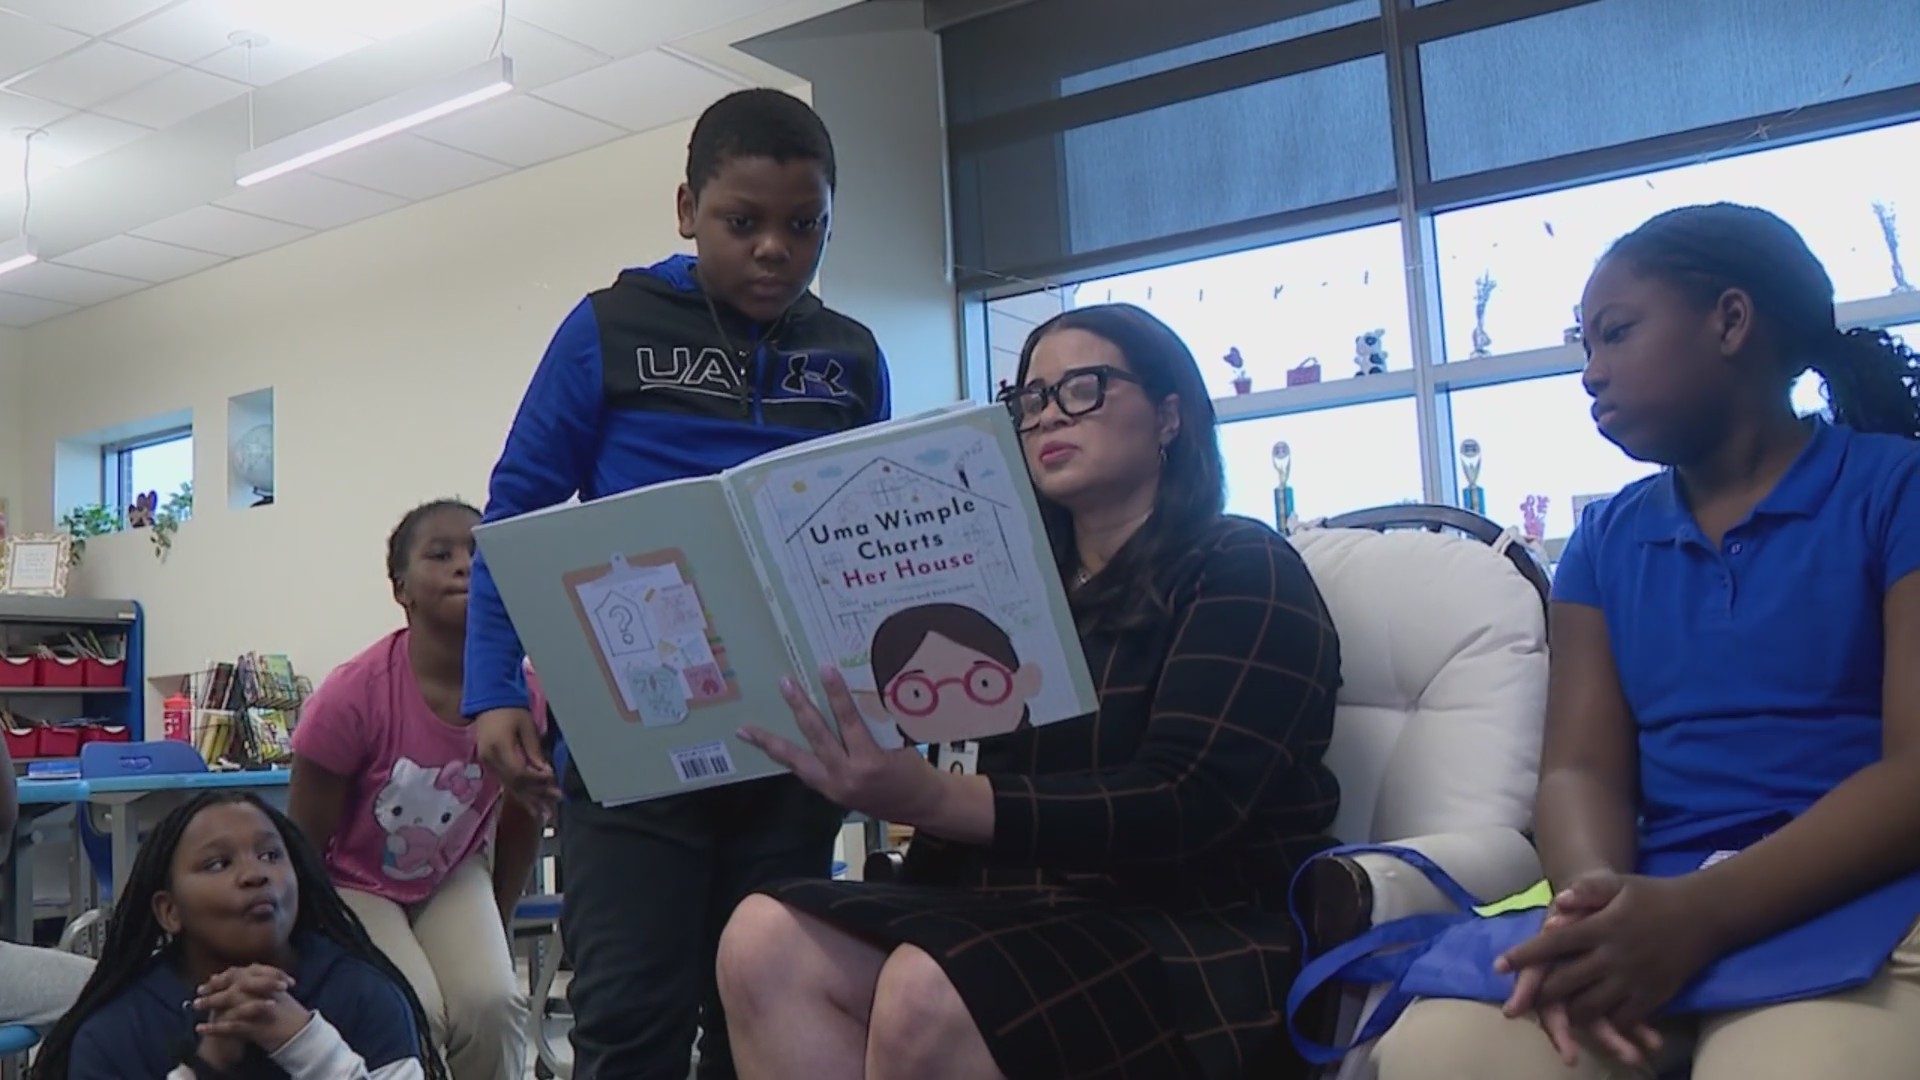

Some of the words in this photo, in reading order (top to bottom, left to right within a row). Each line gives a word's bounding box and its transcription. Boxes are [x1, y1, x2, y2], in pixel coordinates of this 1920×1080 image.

[809, 524, 869, 545] Uma
[874, 496, 976, 531] Wimple
[857, 533, 944, 560] Charts
[842, 569, 887, 589] Her
[894, 552, 975, 579] House
